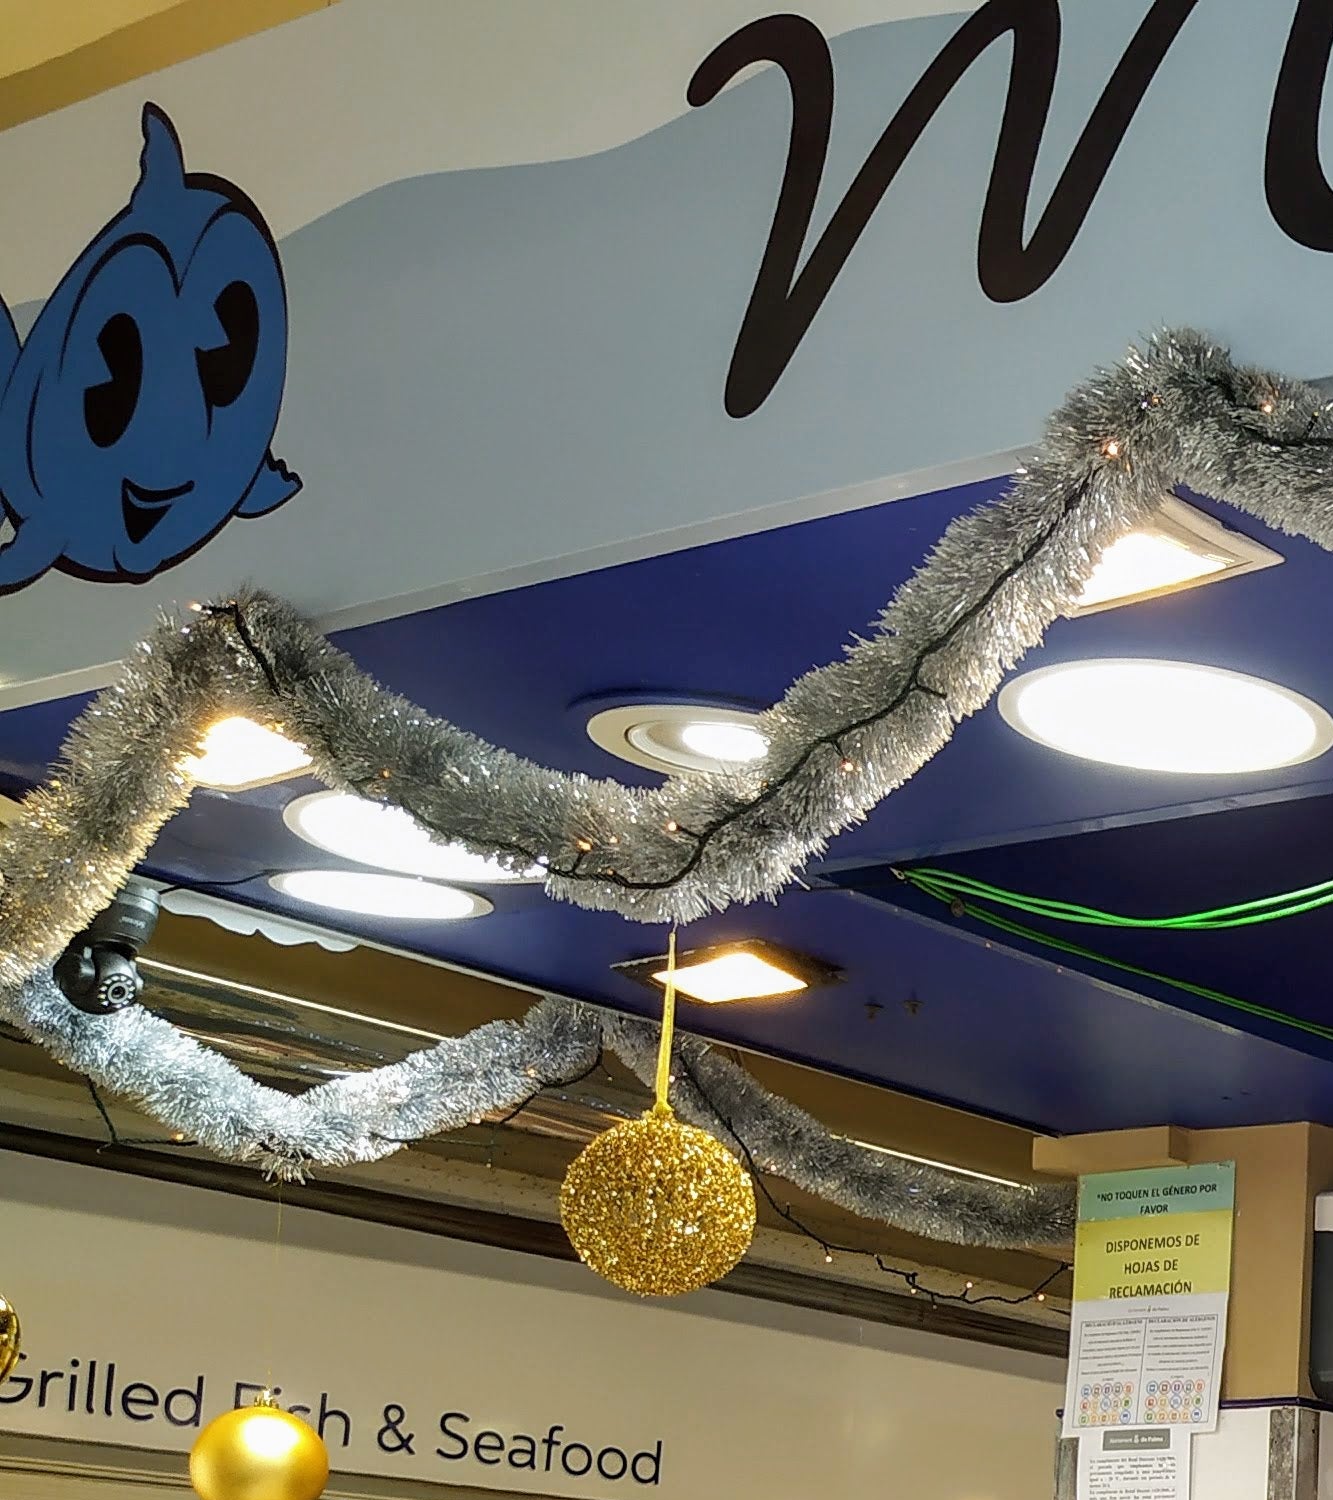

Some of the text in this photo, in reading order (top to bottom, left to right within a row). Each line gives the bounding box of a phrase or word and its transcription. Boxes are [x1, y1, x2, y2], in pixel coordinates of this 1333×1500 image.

[1115, 1189, 1149, 1201] TOQUEN
[1151, 1189, 1160, 1198] EL
[1162, 1184, 1197, 1197] GÉNERO
[1199, 1183, 1217, 1193] POR
[1140, 1204, 1169, 1215] FAVOR
[1105, 1234, 1200, 1254] DISPONEMOS DE
[1124, 1259, 1179, 1274] HOJAS DE
[1108, 1280, 1192, 1299] RECLAMACIÓN
[0, 1353, 203, 1427] Grilled
[377, 1404, 416, 1455] &
[436, 1411, 663, 1487] Seafood
